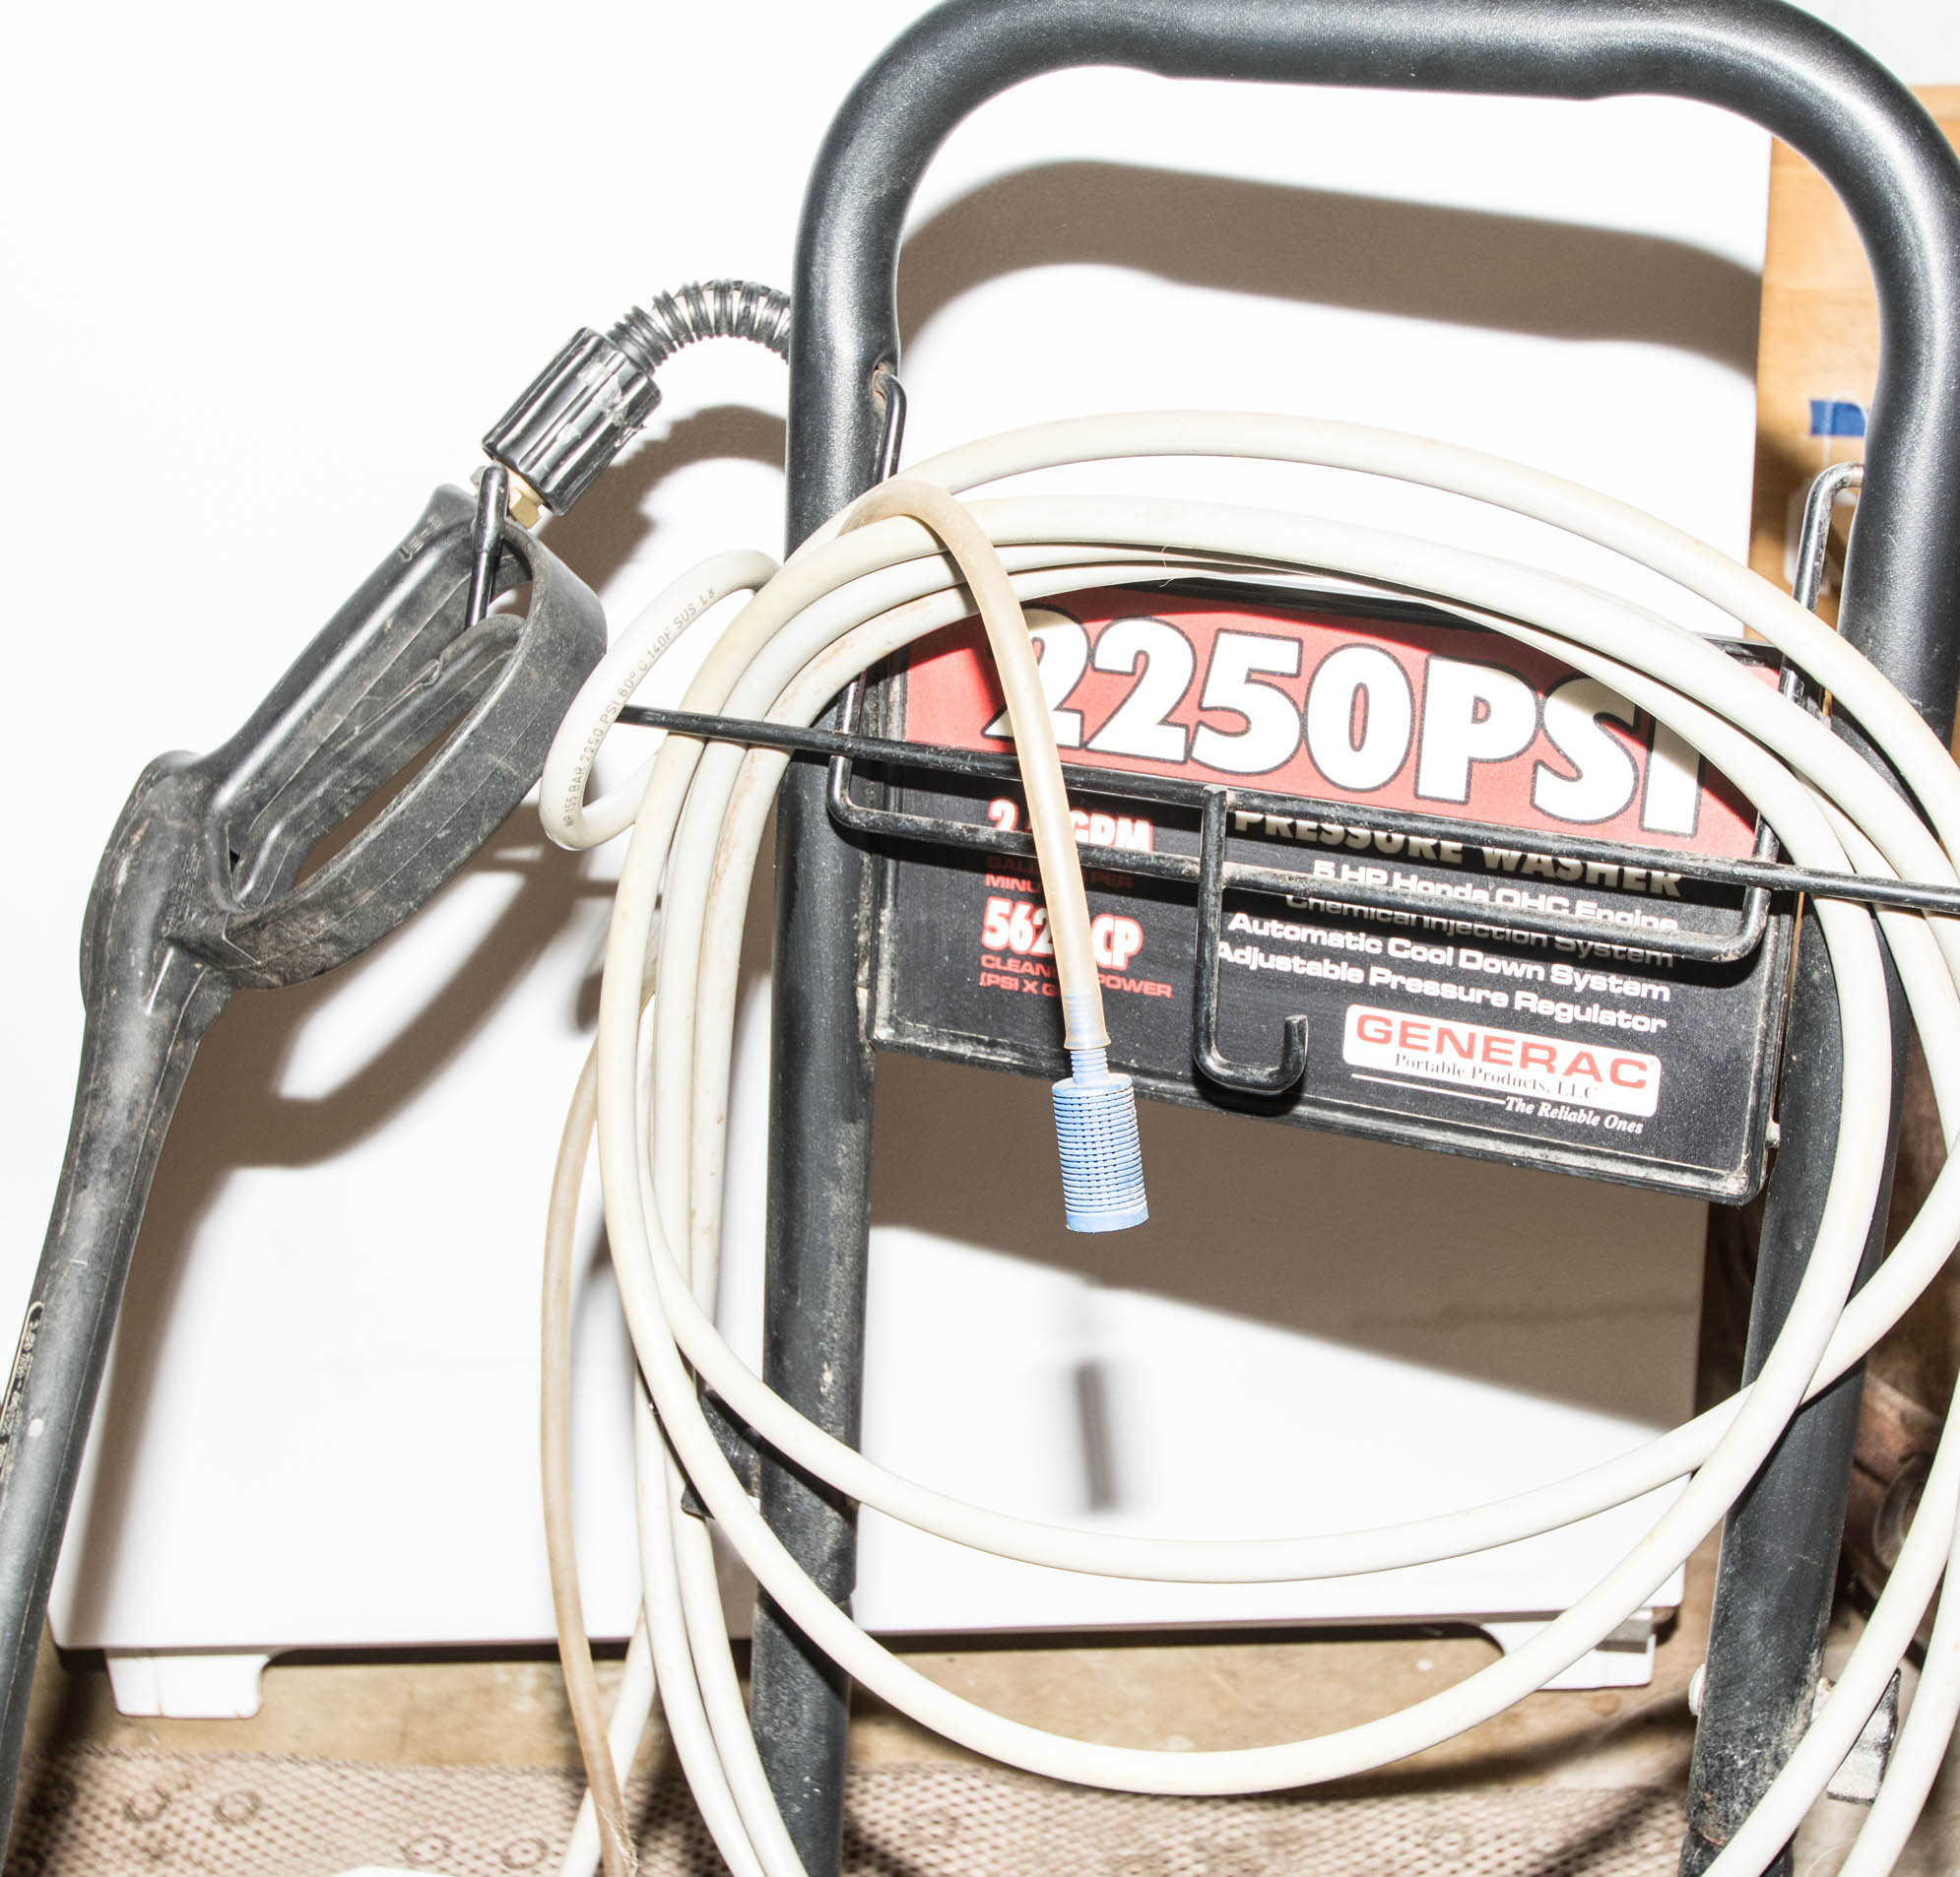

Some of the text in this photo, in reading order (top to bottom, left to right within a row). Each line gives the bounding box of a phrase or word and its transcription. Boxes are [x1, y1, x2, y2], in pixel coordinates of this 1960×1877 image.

[568, 767, 584, 794] BAR
[580, 728, 604, 762] 2250
[599, 700, 621, 725] PSI
[673, 603, 696, 630] SUS
[1392, 871, 1489, 902] Honda
[981, 896, 1144, 970] 562 CP
[1227, 912, 1671, 1002] Automatic Cool Down System
[1553, 934, 1675, 969] System
[1218, 940, 1667, 1034] Adjustable Pressure Regulator
[1356, 1013, 1648, 1089] GENERAC
[1395, 1053, 1466, 1077] Portable
[1505, 1096, 1645, 1134] The Reliable Ones
